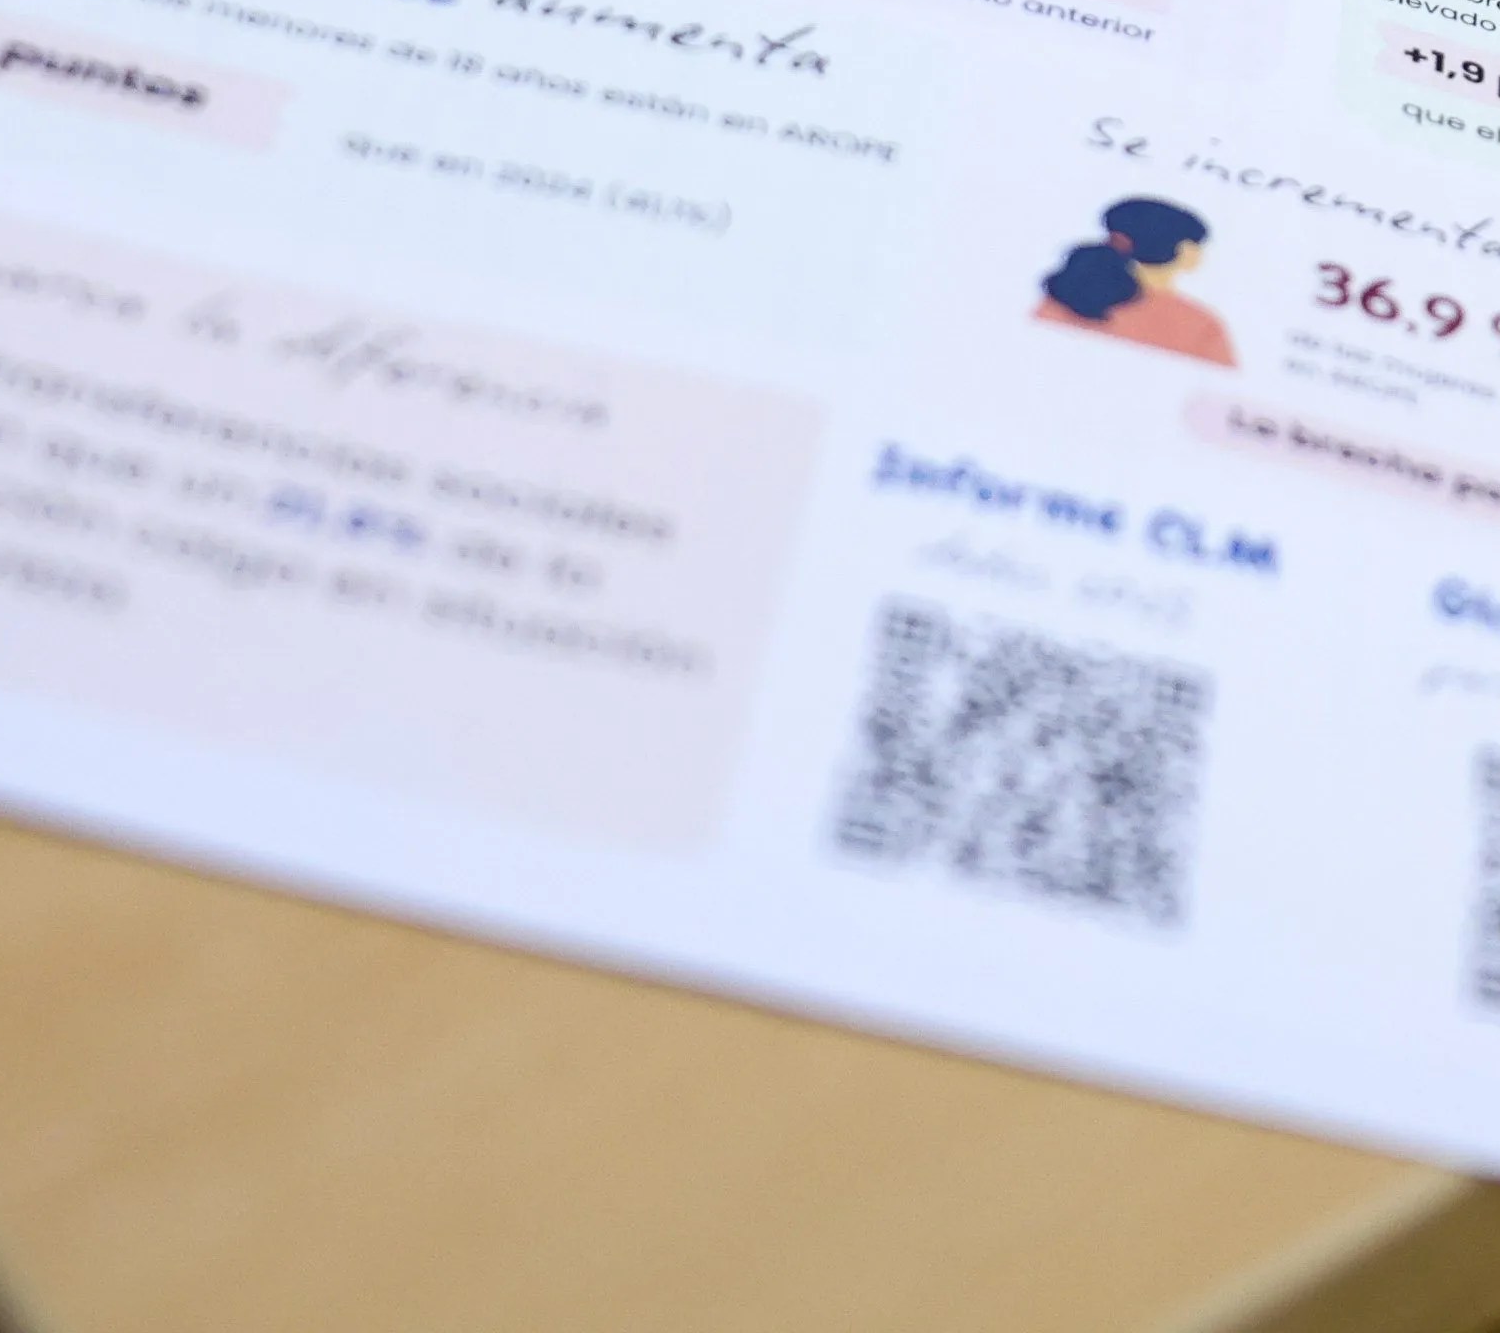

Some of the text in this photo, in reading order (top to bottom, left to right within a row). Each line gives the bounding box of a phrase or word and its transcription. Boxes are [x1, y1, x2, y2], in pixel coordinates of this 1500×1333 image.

[1021, 0, 1155, 42] anterior
[1404, 47, 1485, 84] +1,9
[1086, 116, 1149, 160] Se
[1401, 102, 1466, 132] que
[871, 442, 1282, 576] Informe CLM
